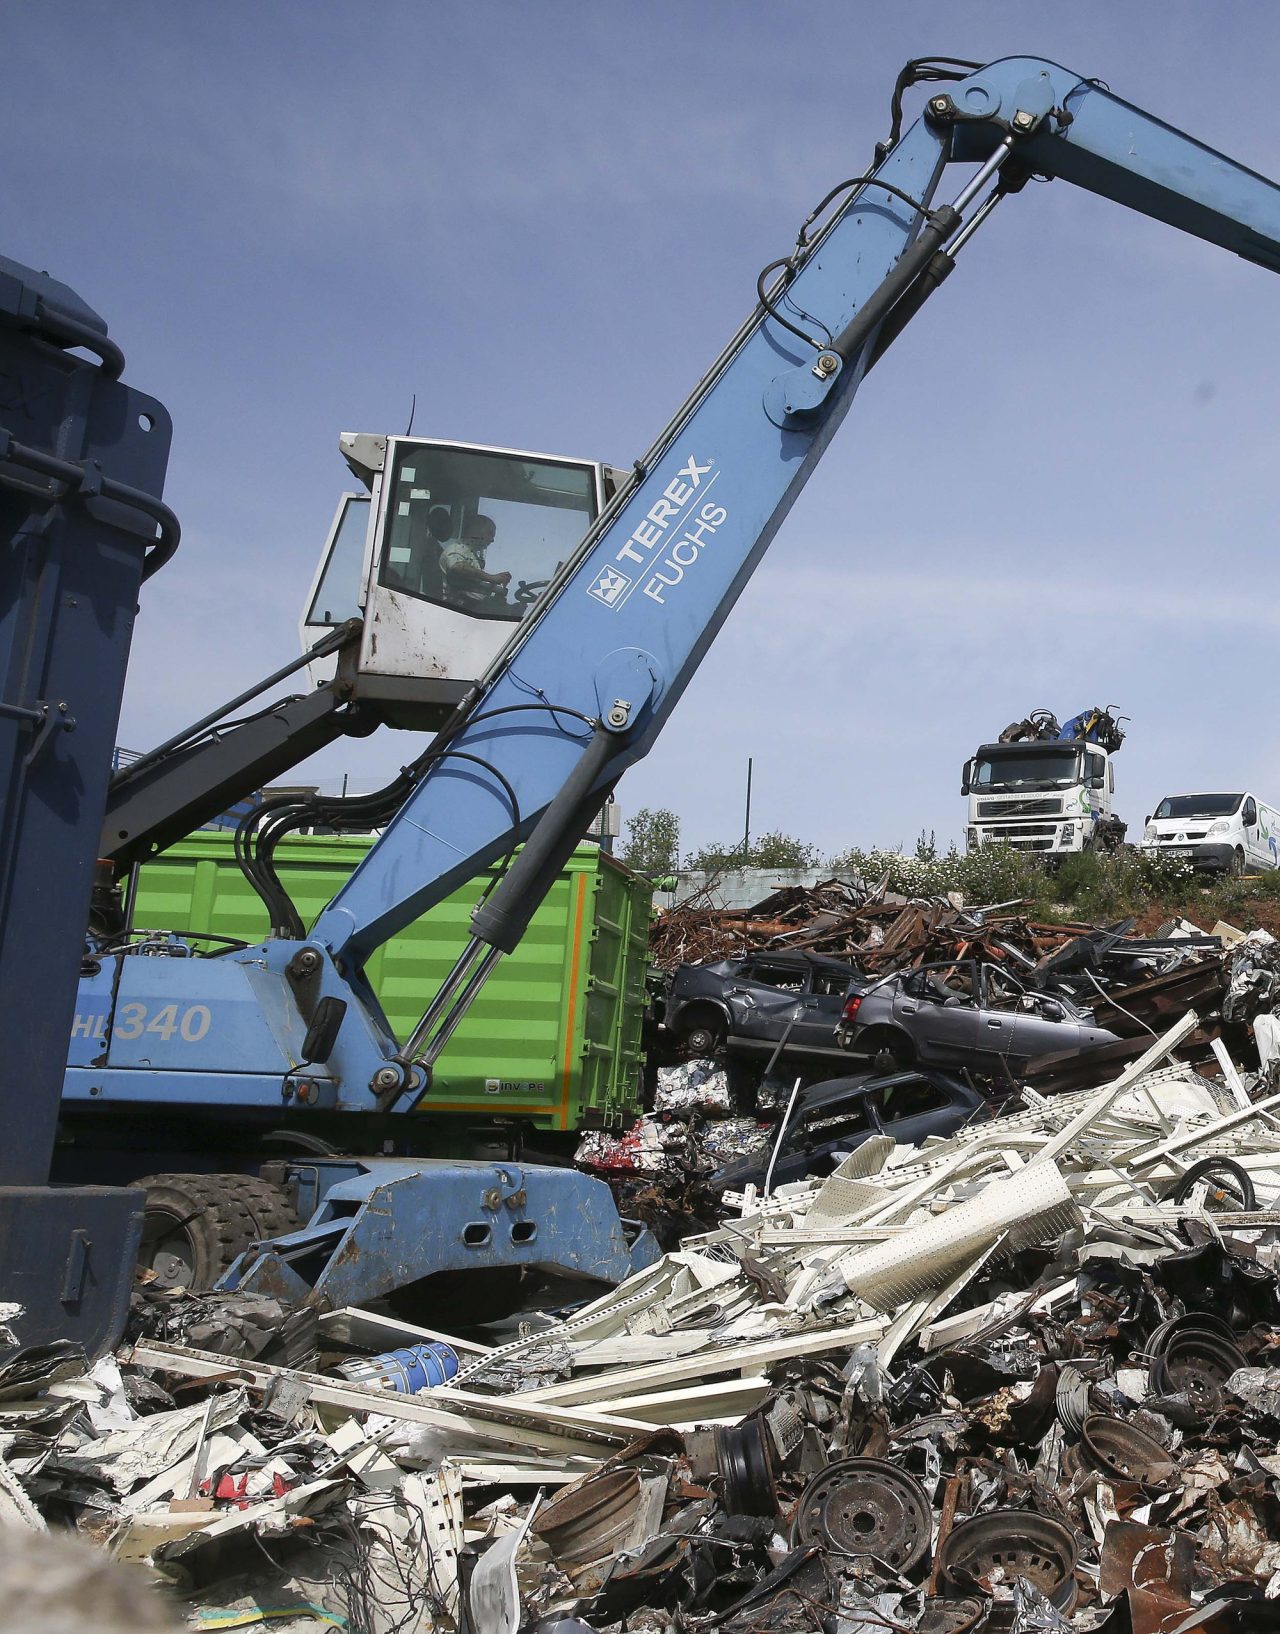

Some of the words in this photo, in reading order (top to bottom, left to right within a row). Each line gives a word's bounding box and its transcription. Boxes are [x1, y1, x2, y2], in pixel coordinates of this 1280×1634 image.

[615, 455, 712, 564] TEREX
[643, 502, 728, 605] FUCHS
[114, 1002, 212, 1042] 340
